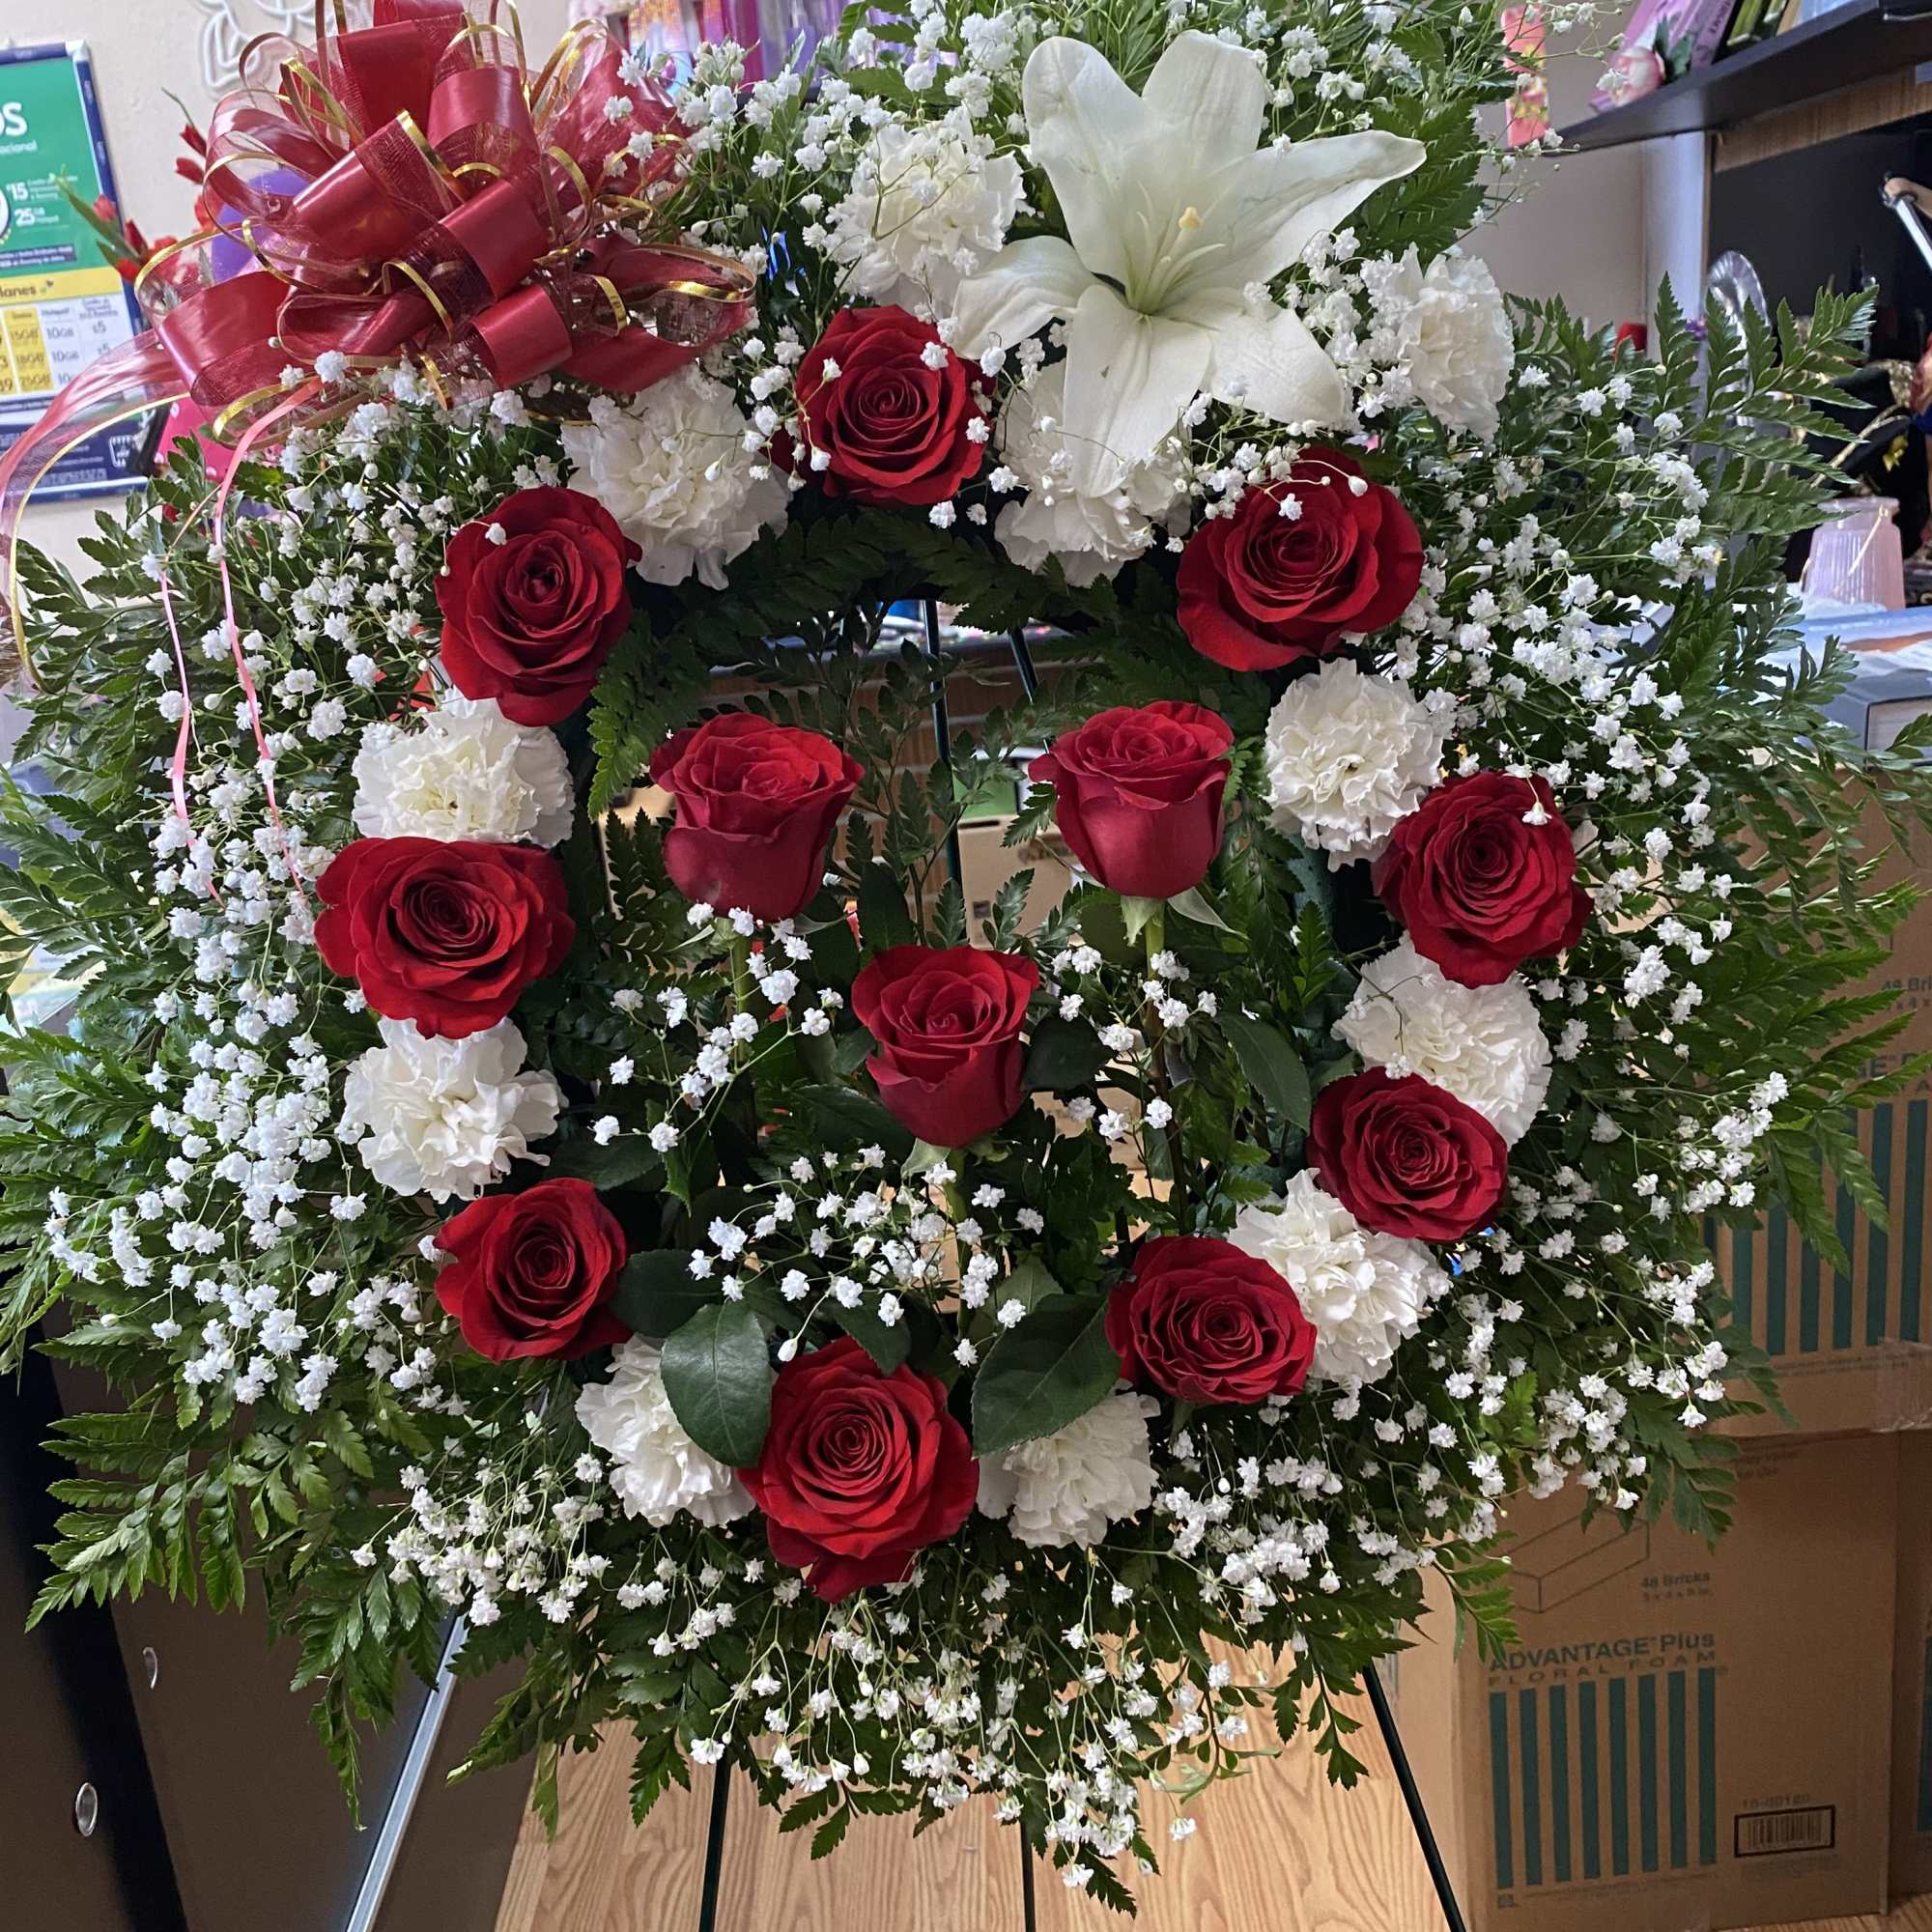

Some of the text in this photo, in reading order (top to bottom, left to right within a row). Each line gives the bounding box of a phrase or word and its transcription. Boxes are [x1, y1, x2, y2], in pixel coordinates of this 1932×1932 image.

[0, 101, 28, 136] S
[1661, 1632, 1716, 1653] Plus
[1489, 1651, 1716, 1687] FLORAL FOAM
